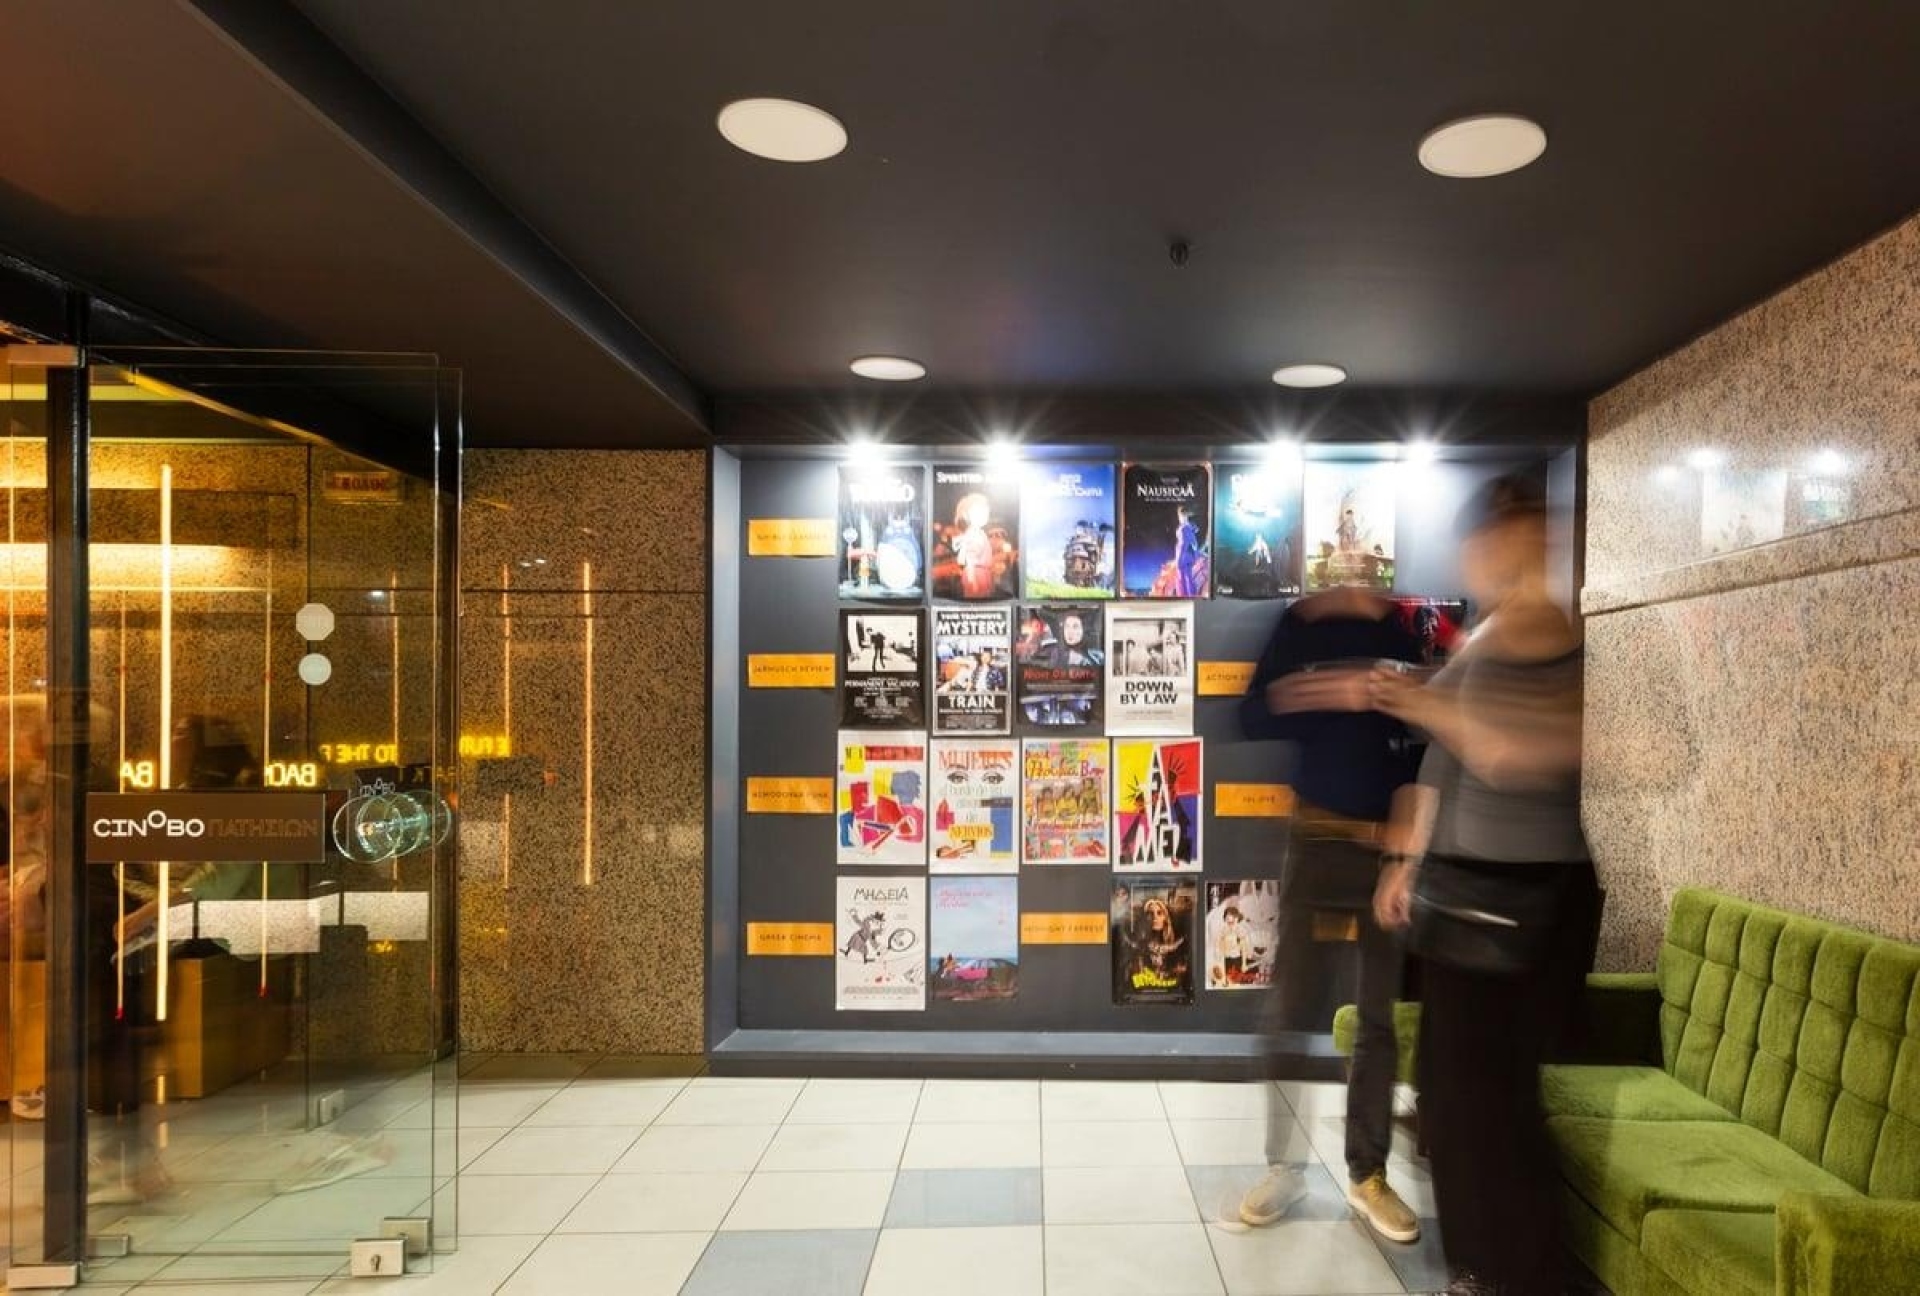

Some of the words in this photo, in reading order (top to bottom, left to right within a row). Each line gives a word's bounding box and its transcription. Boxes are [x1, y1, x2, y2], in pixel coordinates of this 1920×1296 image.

[936, 620, 1006, 635] MYSTERY
[1125, 681, 1174, 693] DOWN
[949, 696, 995, 709] TRAIN
[1120, 694, 1139, 705] BY
[1144, 694, 1178, 705] LAW
